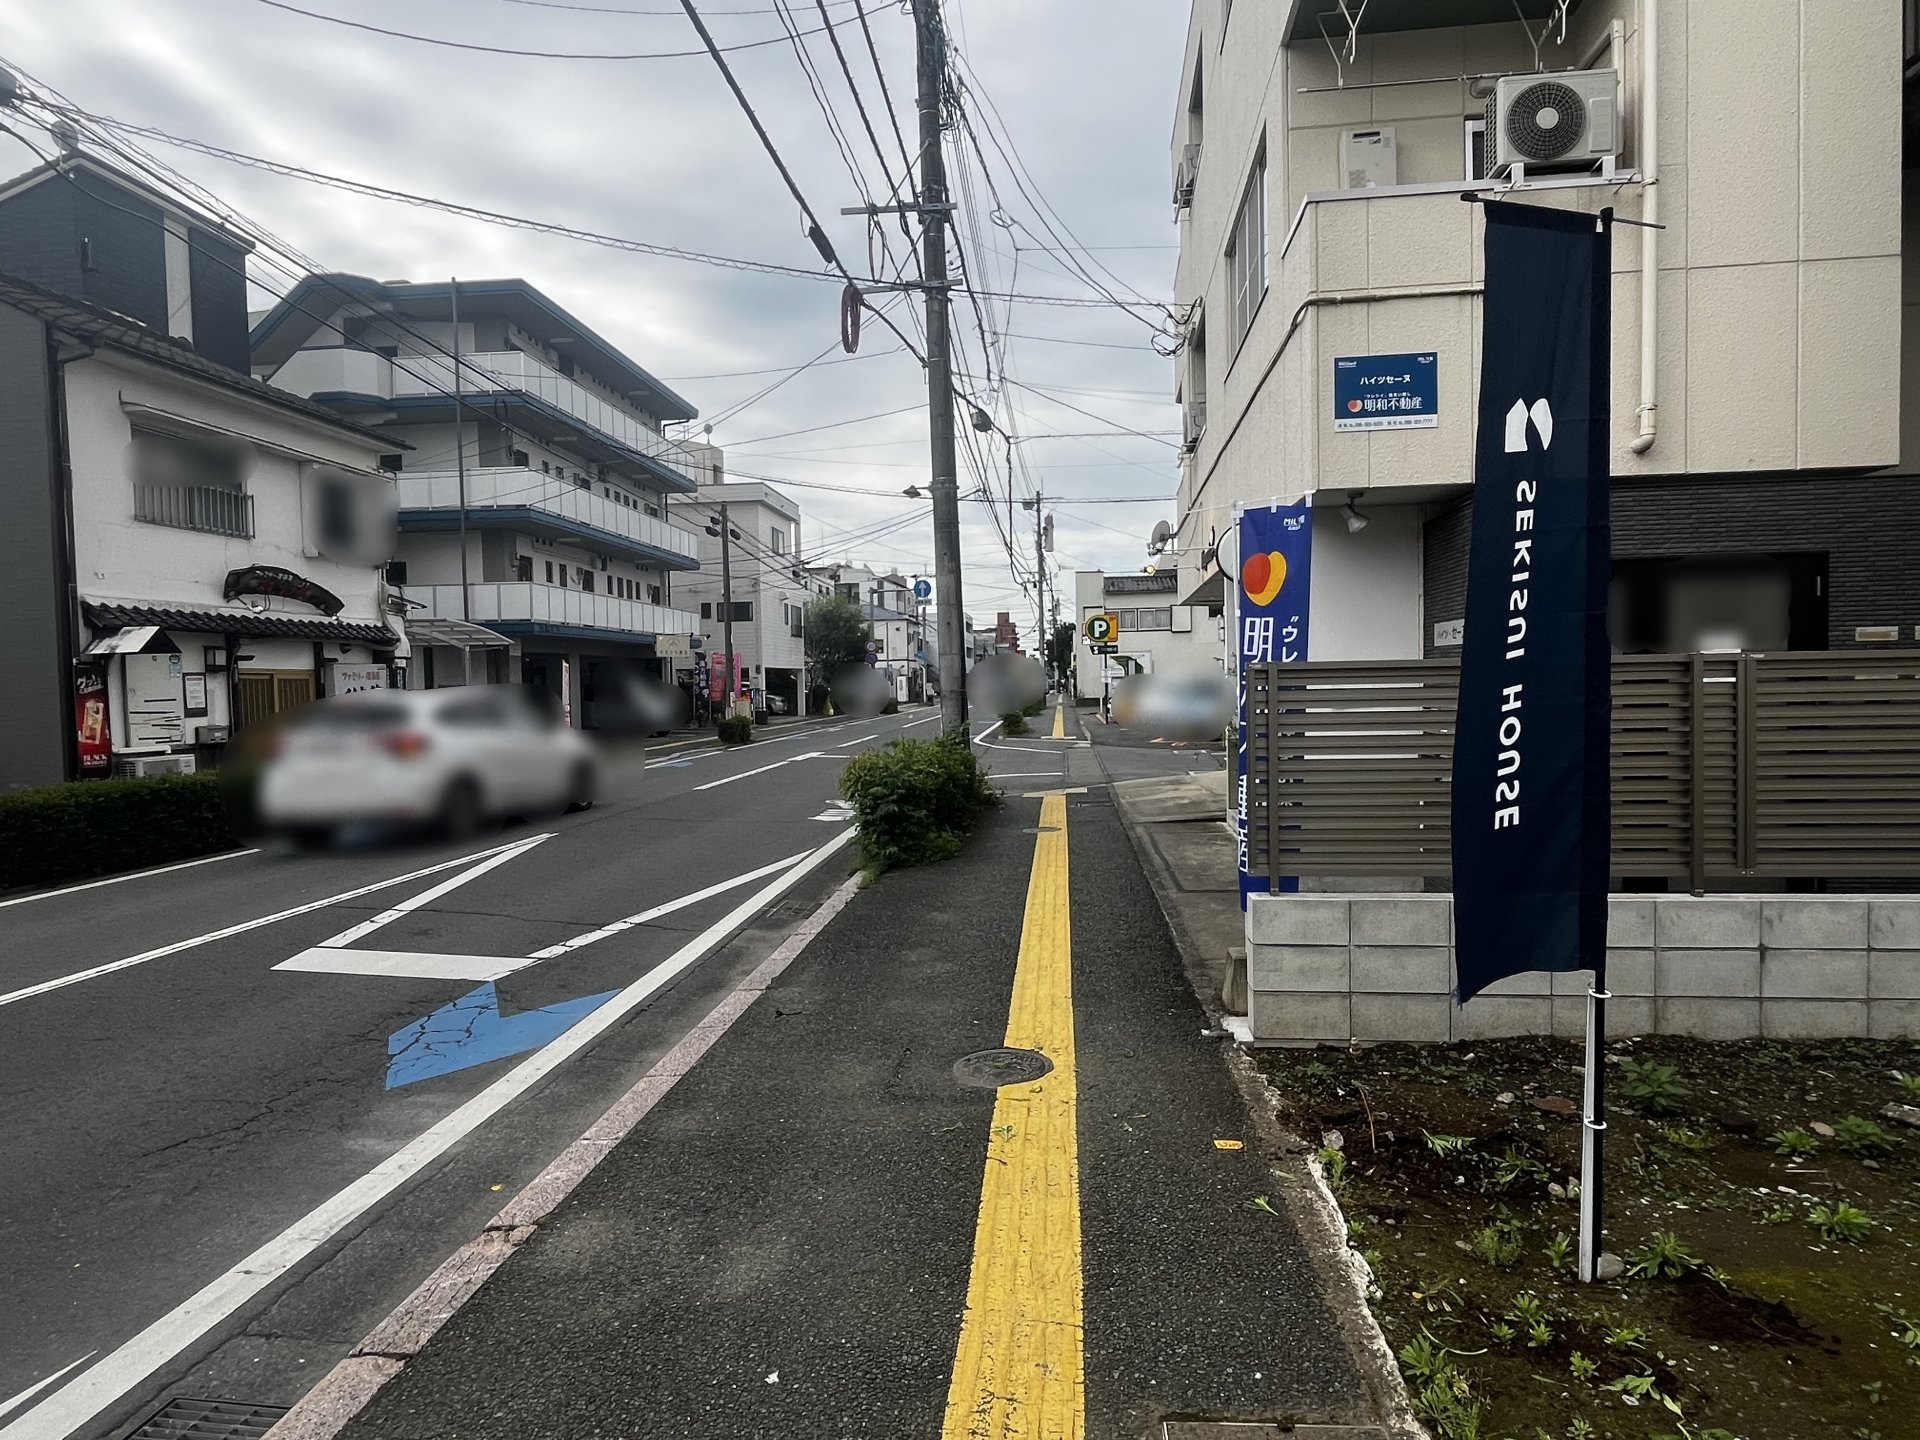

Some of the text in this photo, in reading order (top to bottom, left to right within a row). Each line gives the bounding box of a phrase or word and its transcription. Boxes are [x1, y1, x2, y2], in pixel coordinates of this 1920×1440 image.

[1360, 374, 1411, 385] ハイツセーヌ
[1364, 396, 1423, 411] 明和不動産
[1094, 620, 1107, 638] P
